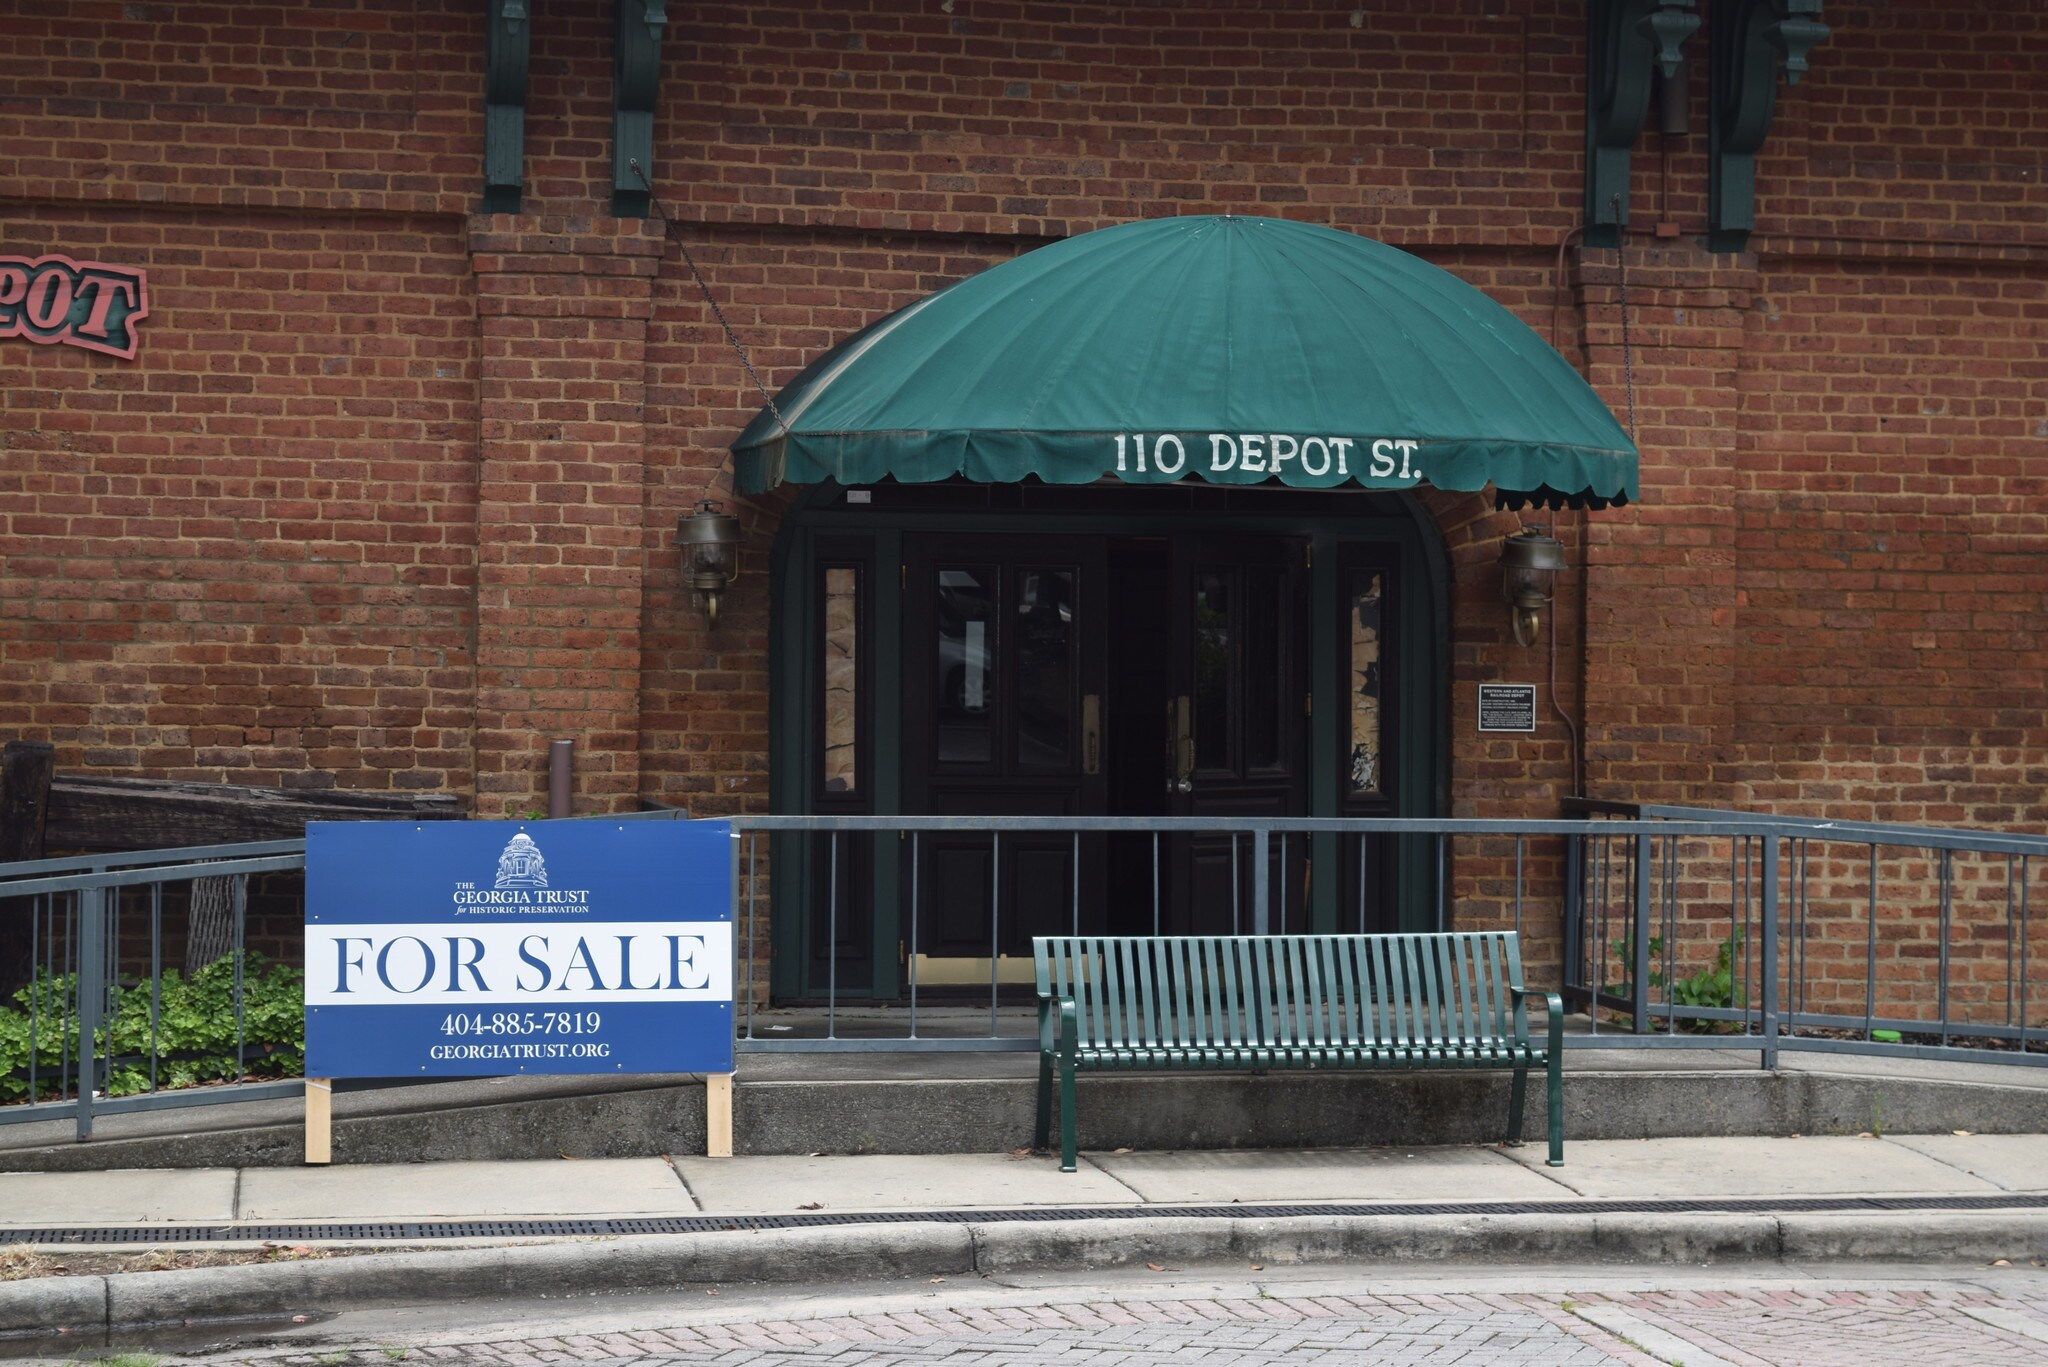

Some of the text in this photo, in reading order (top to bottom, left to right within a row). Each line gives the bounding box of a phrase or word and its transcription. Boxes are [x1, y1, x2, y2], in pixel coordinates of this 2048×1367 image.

[1114, 434, 1422, 479] 110 DEPOT ST.
[453, 890, 590, 904] GEORGIA TRUST
[454, 905, 589, 915] for HISTORIC PRESERVATION
[329, 935, 710, 994] FOR SALE
[440, 1012, 600, 1035] 404-885-7819
[430, 1043, 611, 1060] GEORGIATRUST.ORG
